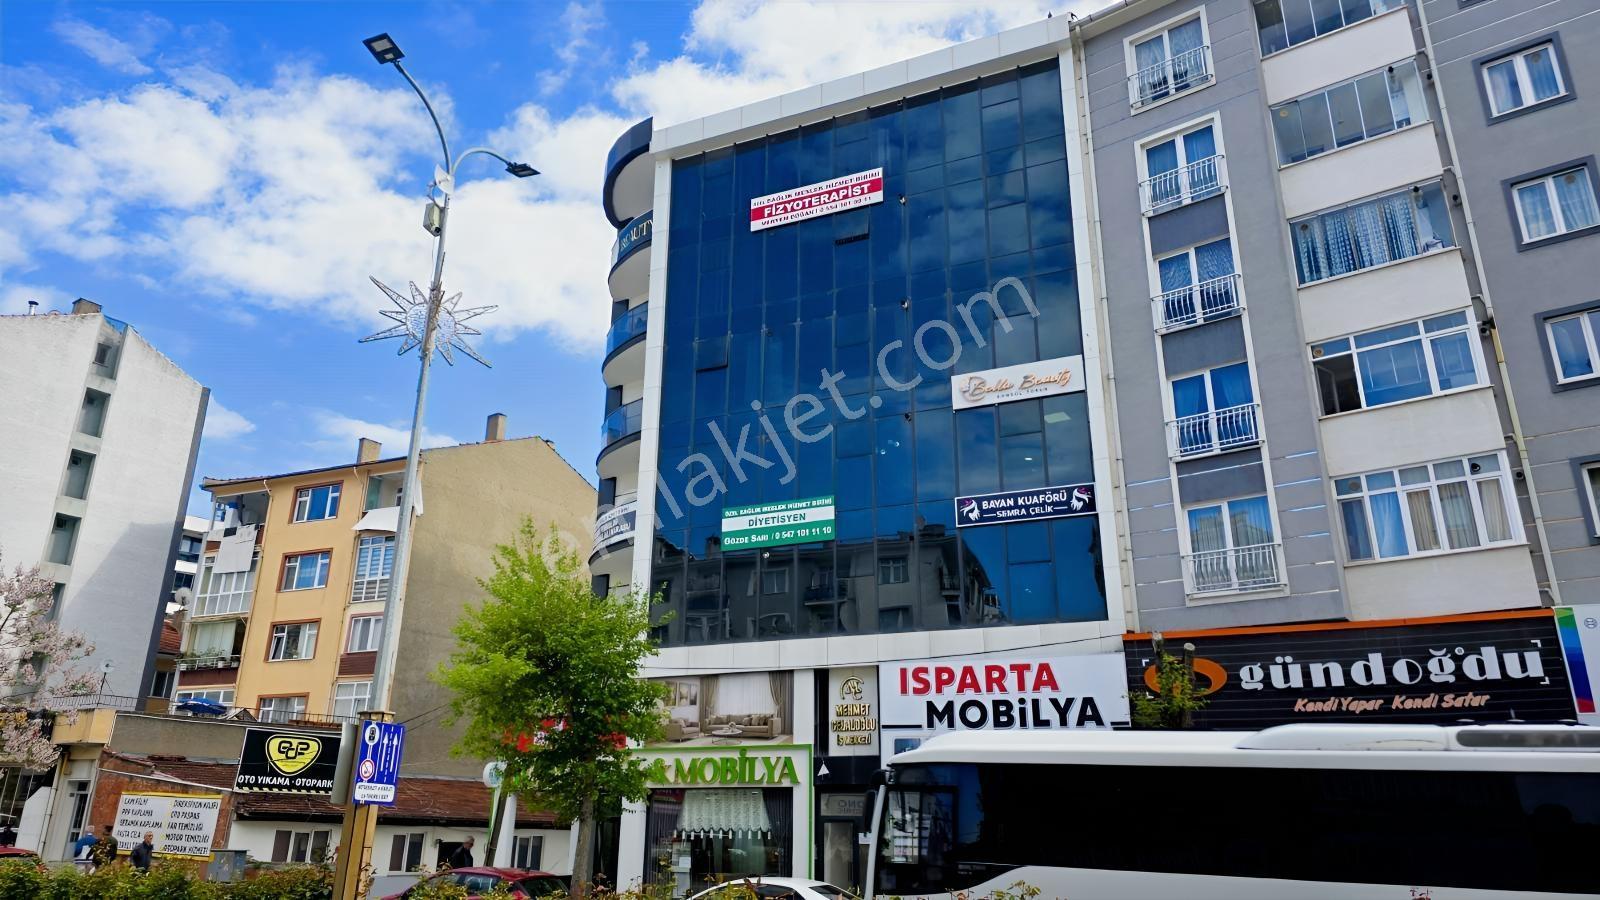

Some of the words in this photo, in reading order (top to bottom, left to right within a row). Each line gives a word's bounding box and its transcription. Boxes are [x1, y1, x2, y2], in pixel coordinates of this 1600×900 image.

[764, 183, 870, 218] FİZYOTERAPİST
[1019, 367, 1072, 391] Beauty
[982, 497, 1014, 510] BAYAN
[1017, 489, 1067, 506] KUAFÖRÜ
[748, 512, 806, 527] DİYETİSYEN
[996, 508, 1027, 518] SEMRA
[1029, 504, 1053, 515] ÇELİK
[797, 528, 809, 537] 101
[812, 527, 820, 535] 11
[822, 526, 832, 535] 10
[899, 662, 1061, 696] ISPARTA
[835, 703, 870, 717] MEHMET
[1294, 696, 1339, 713] Kendi
[1340, 696, 1384, 714] Yapar
[1391, 693, 1438, 710] Kendi
[1441, 691, 1490, 708] Satar
[673, 748, 800, 785] MOBİLYA
[238, 774, 255, 784] OTO
[257, 775, 290, 786] YIKAMA
[295, 778, 333, 789] OTOPARK
